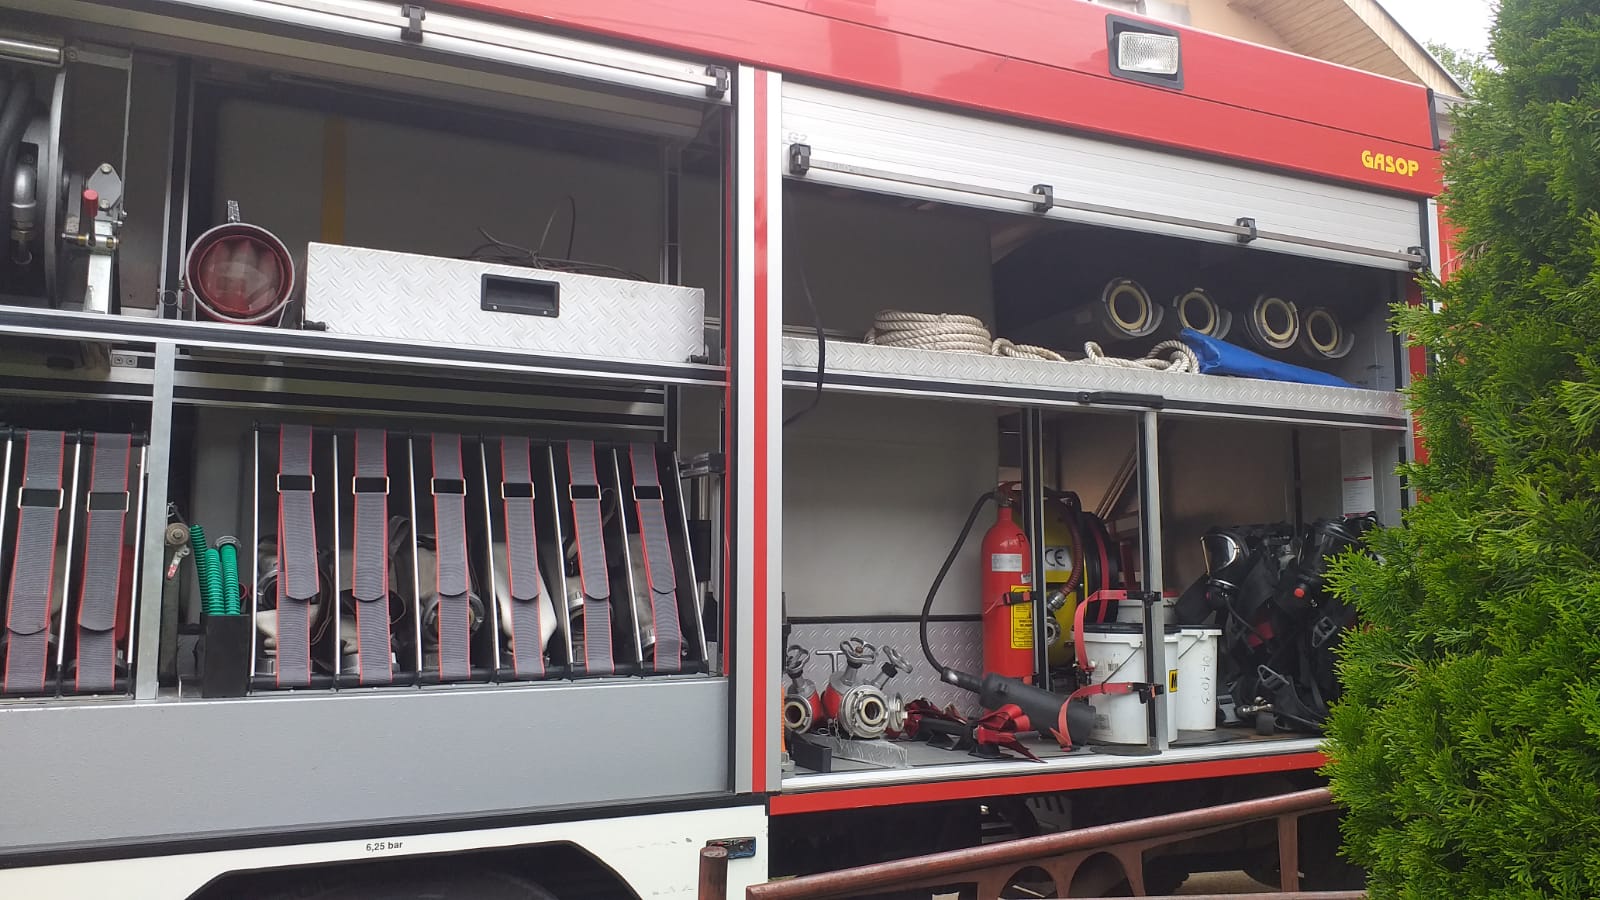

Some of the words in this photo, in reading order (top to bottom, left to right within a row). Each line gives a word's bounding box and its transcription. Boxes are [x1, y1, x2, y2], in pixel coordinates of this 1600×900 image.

[1361, 149, 1420, 177] GASOP
[1044, 548, 1066, 568] CE
[366, 842, 385, 852] 6,25
[387, 841, 403, 850] bar
